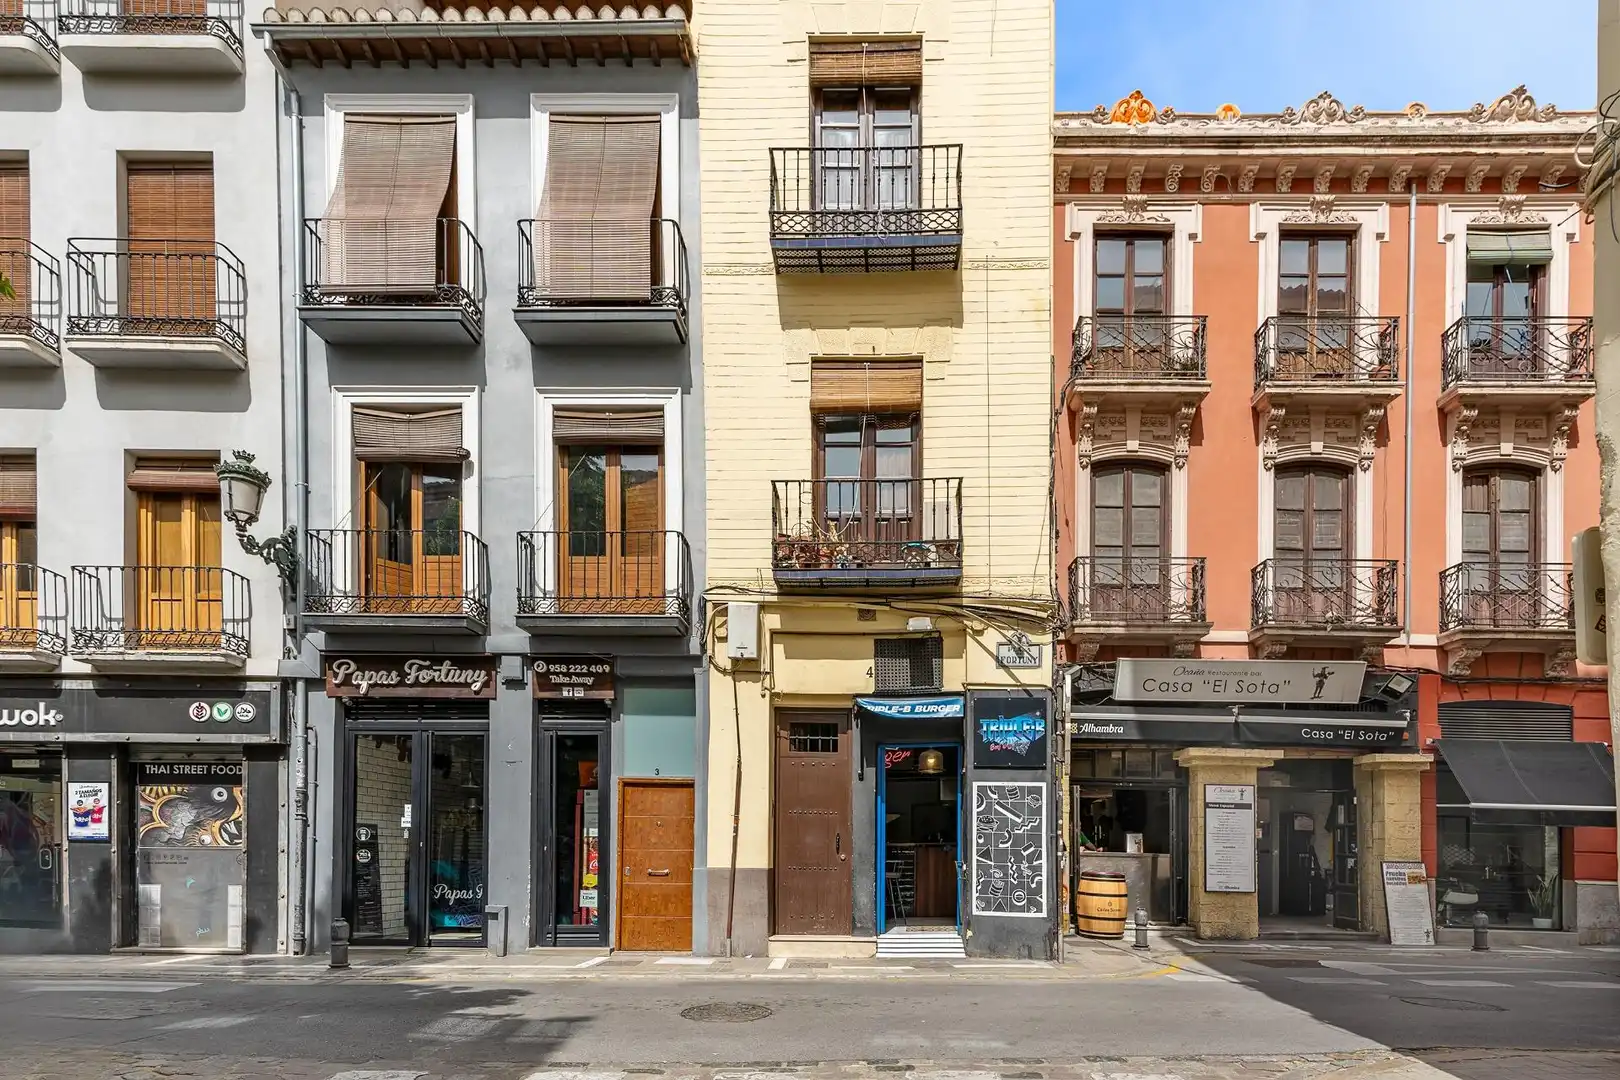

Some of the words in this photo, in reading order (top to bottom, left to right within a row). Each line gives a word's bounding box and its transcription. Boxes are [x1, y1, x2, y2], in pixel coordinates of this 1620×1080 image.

[1000, 655, 1038, 664] FORTUNY
[549, 664, 568, 673] 958
[569, 664, 588, 673] 222
[589, 664, 610, 673] 409
[866, 666, 873, 678] 4
[332, 659, 401, 694] Papas
[404, 659, 488, 691] Fortuny
[549, 674, 570, 684] Take
[571, 675, 594, 686] Away
[1142, 678, 1192, 692] Casa
[1203, 679, 1227, 693] “El
[1235, 679, 1291, 694] Sota”
[915, 704, 961, 713] BURGER
[1079, 723, 1124, 734] Alhambra
[1301, 728, 1334, 739] Casa
[1338, 729, 1355, 740] “El
[1358, 730, 1395, 741] Sota”
[145, 764, 170, 775] THAI
[173, 764, 208, 775] STREET
[211, 765, 243, 775] FOOD
[654, 767, 660, 776] 3
[434, 883, 474, 906] Papas
